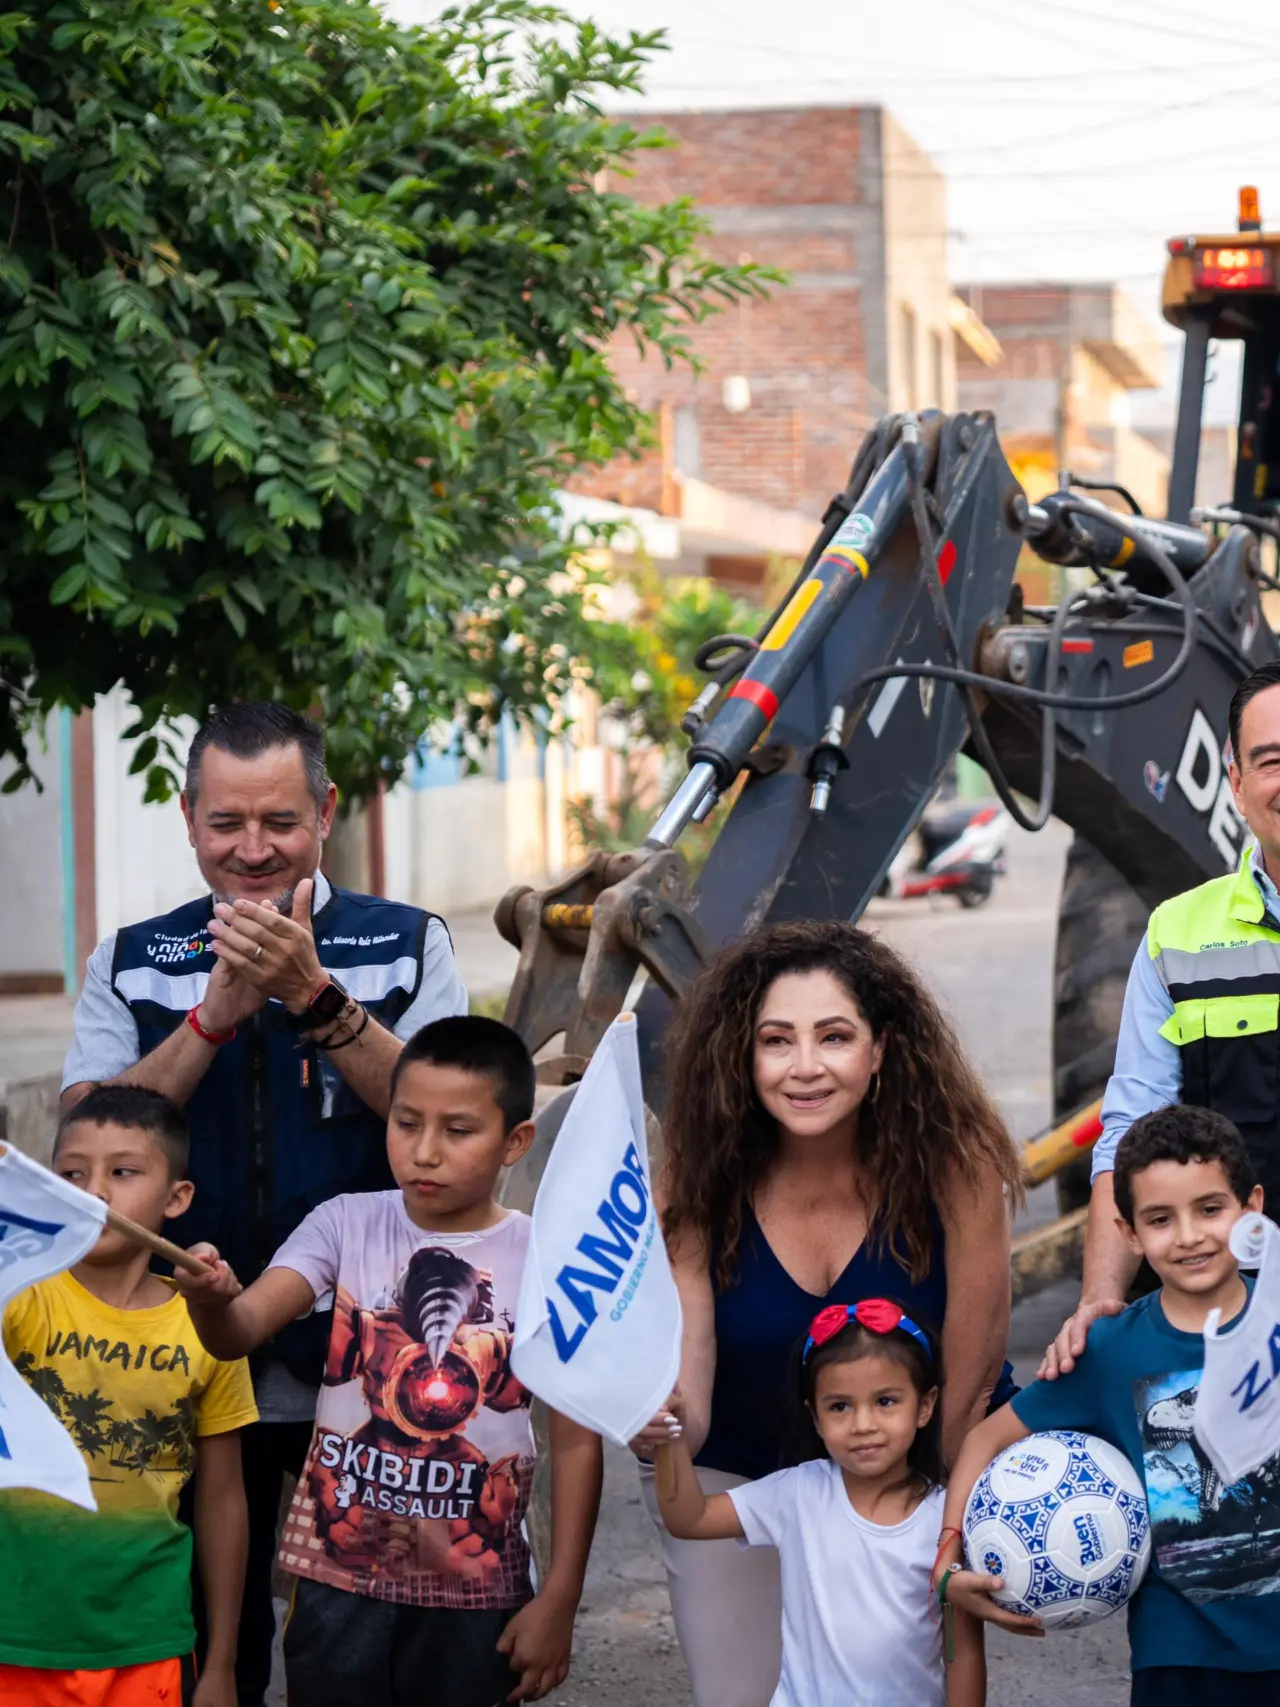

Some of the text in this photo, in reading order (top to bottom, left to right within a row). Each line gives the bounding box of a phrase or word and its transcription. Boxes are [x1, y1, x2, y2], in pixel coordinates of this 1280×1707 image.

[154, 933, 189, 943] Ciudad
[1200, 939, 1248, 950] Carlos Soto
[546, 1142, 649, 1364] ZAMOR
[609, 1250, 649, 1323] GOBIERNO
[46, 1331, 189, 1376] JAMAICA
[320, 1433, 477, 1496] SKIBIDI
[361, 1487, 474, 1519] ASSAULT
[1073, 1516, 1096, 1567] Buen
[1085, 1512, 1103, 1561] Gobierno
